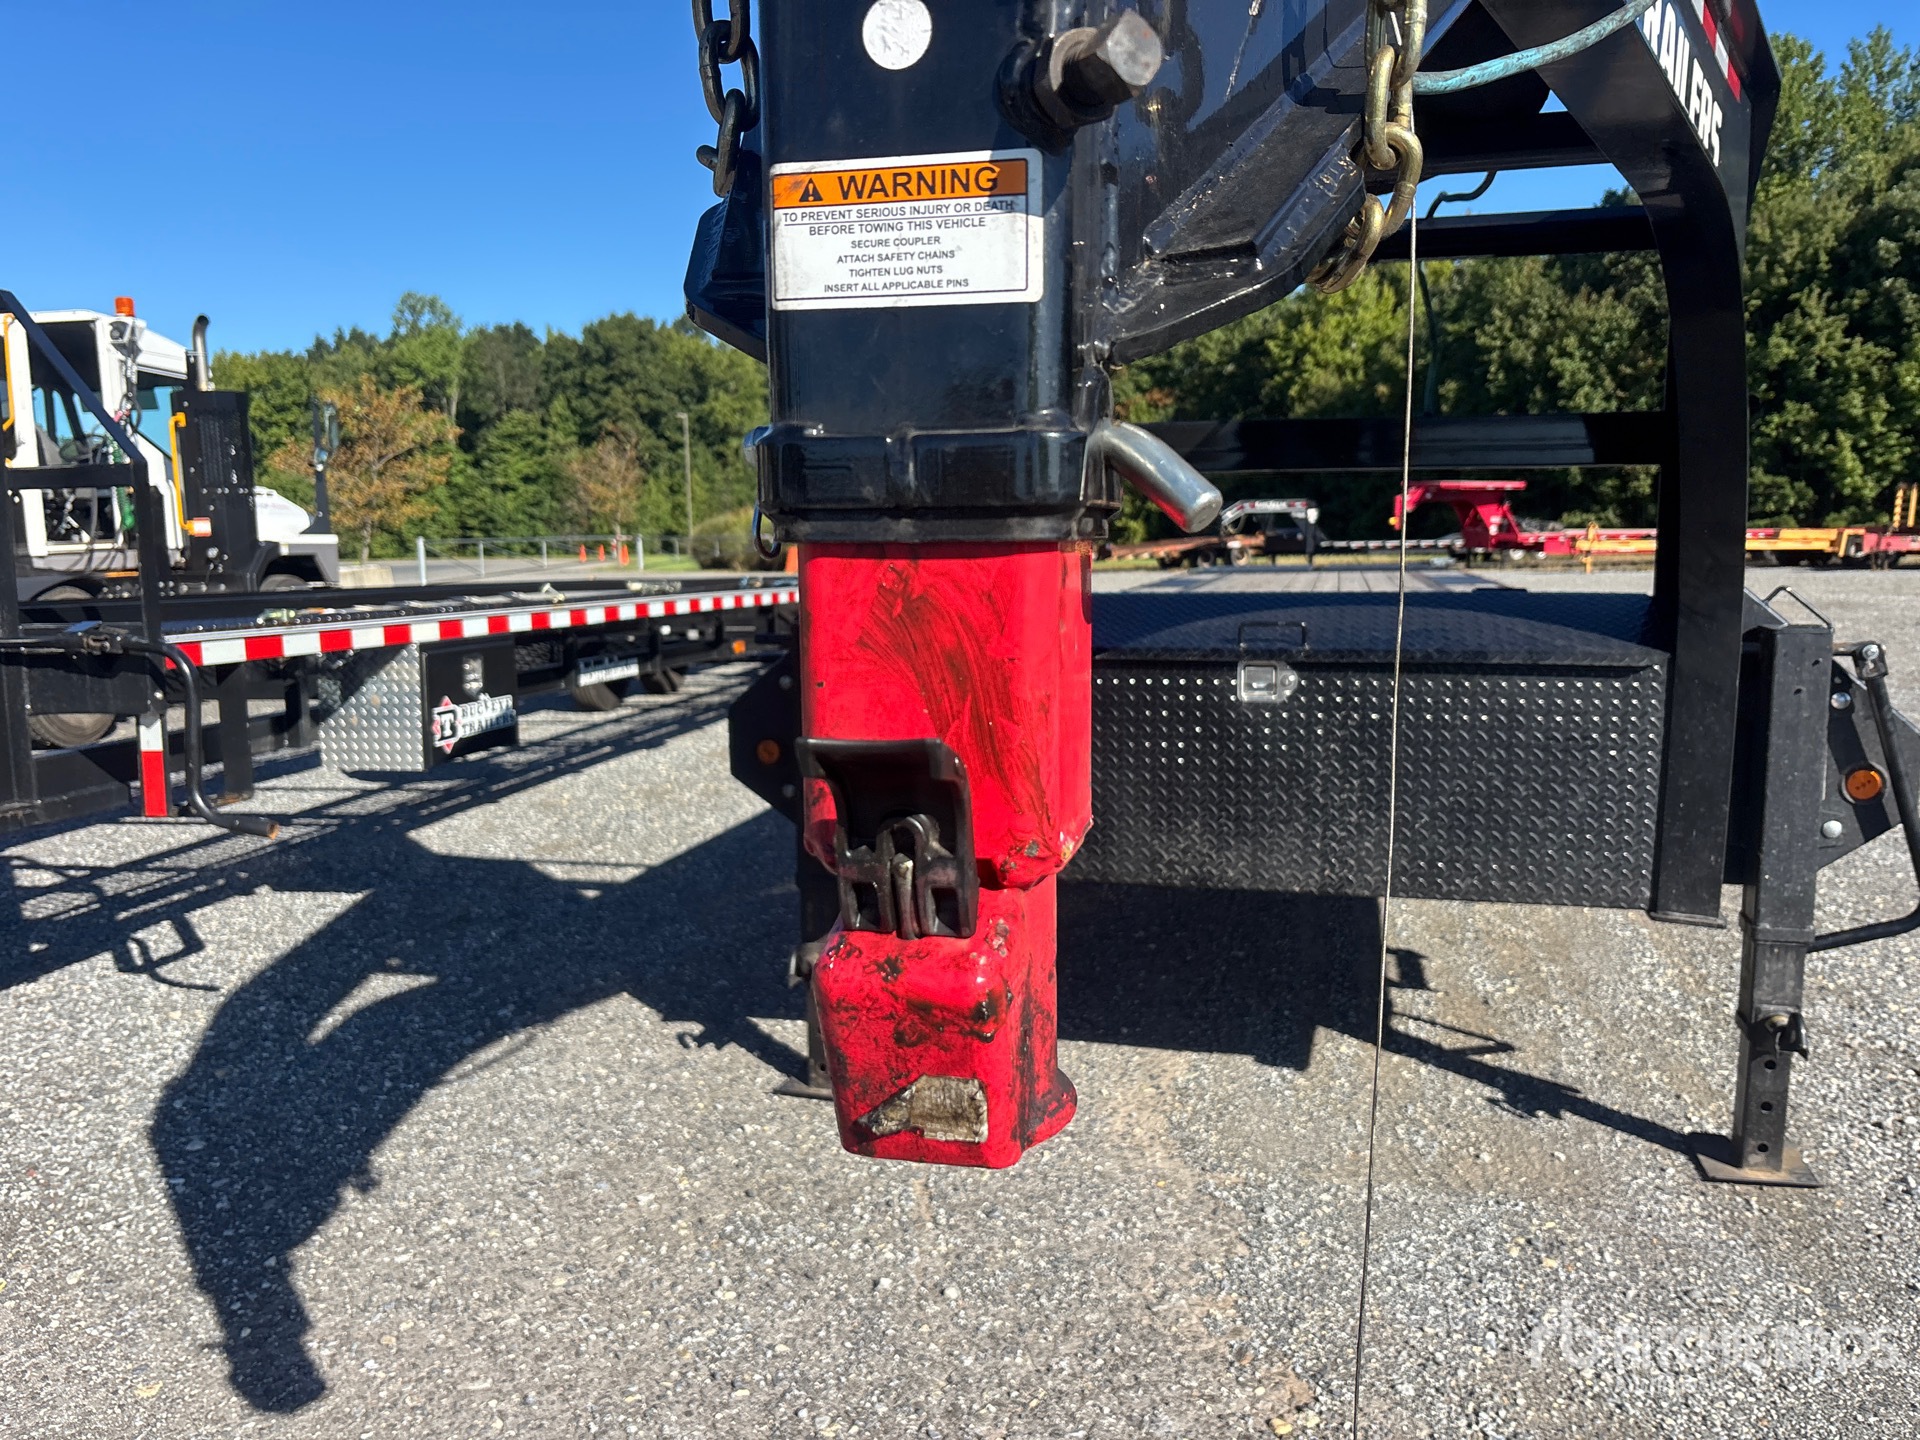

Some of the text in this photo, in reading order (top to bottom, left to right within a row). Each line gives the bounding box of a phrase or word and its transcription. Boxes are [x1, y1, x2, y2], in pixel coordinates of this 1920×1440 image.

[838, 166, 998, 200] WARNING
[783, 200, 1014, 222] TO PREVENT SERIOUS INJURY OR DEATH
[809, 217, 986, 236] BEFORE TOWING THIS VEHICLE
[850, 236, 941, 249] SECURE COUPLER
[837, 250, 955, 264] ATTACH SAFETY CHAINS
[849, 265, 943, 278] TIGHTEN LUG NUTS
[824, 279, 969, 293] INSERT ALL APPLICABLE PINS
